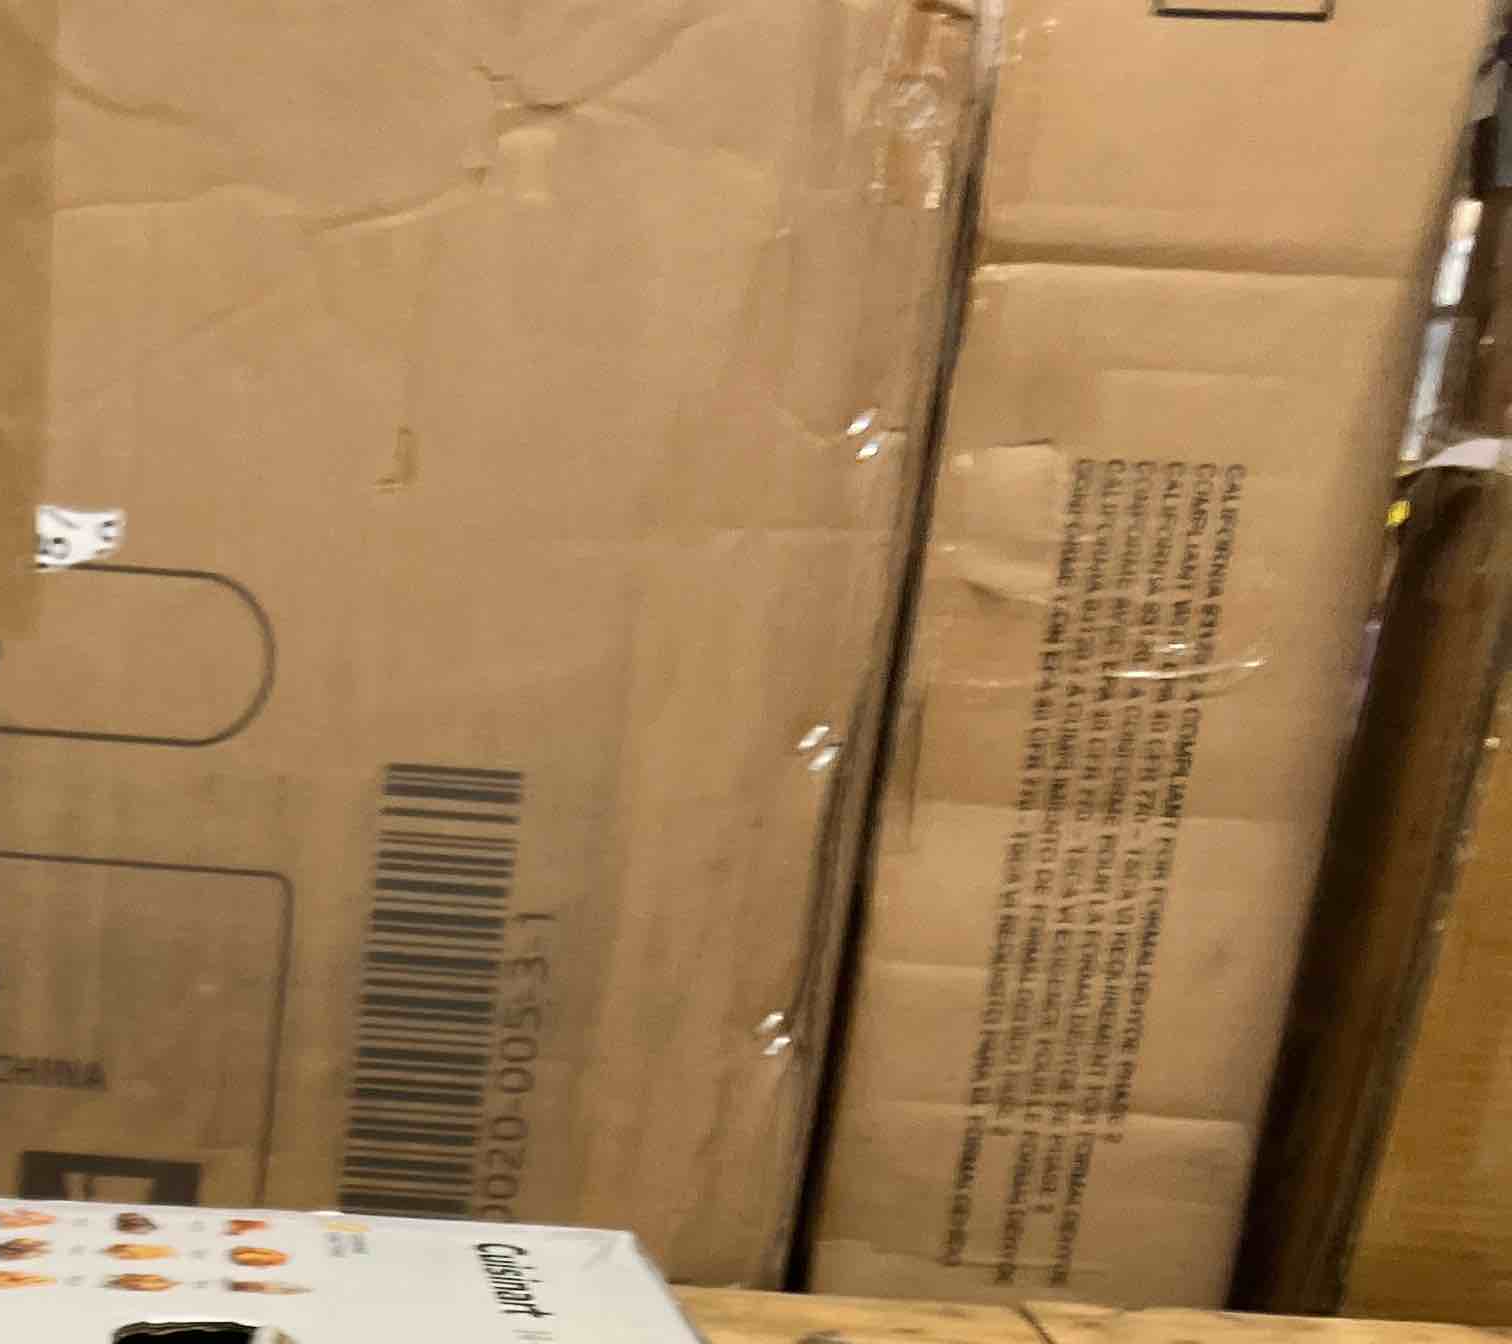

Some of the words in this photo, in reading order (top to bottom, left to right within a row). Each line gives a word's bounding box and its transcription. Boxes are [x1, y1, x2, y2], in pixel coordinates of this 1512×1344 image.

[1174, 463, 1217, 592] COMPLIANT
[1202, 464, 1246, 599] CALIFORNIA
[1160, 707, 1201, 829] COMPLIANT
[475, 1242, 555, 1317] Cuisinart
